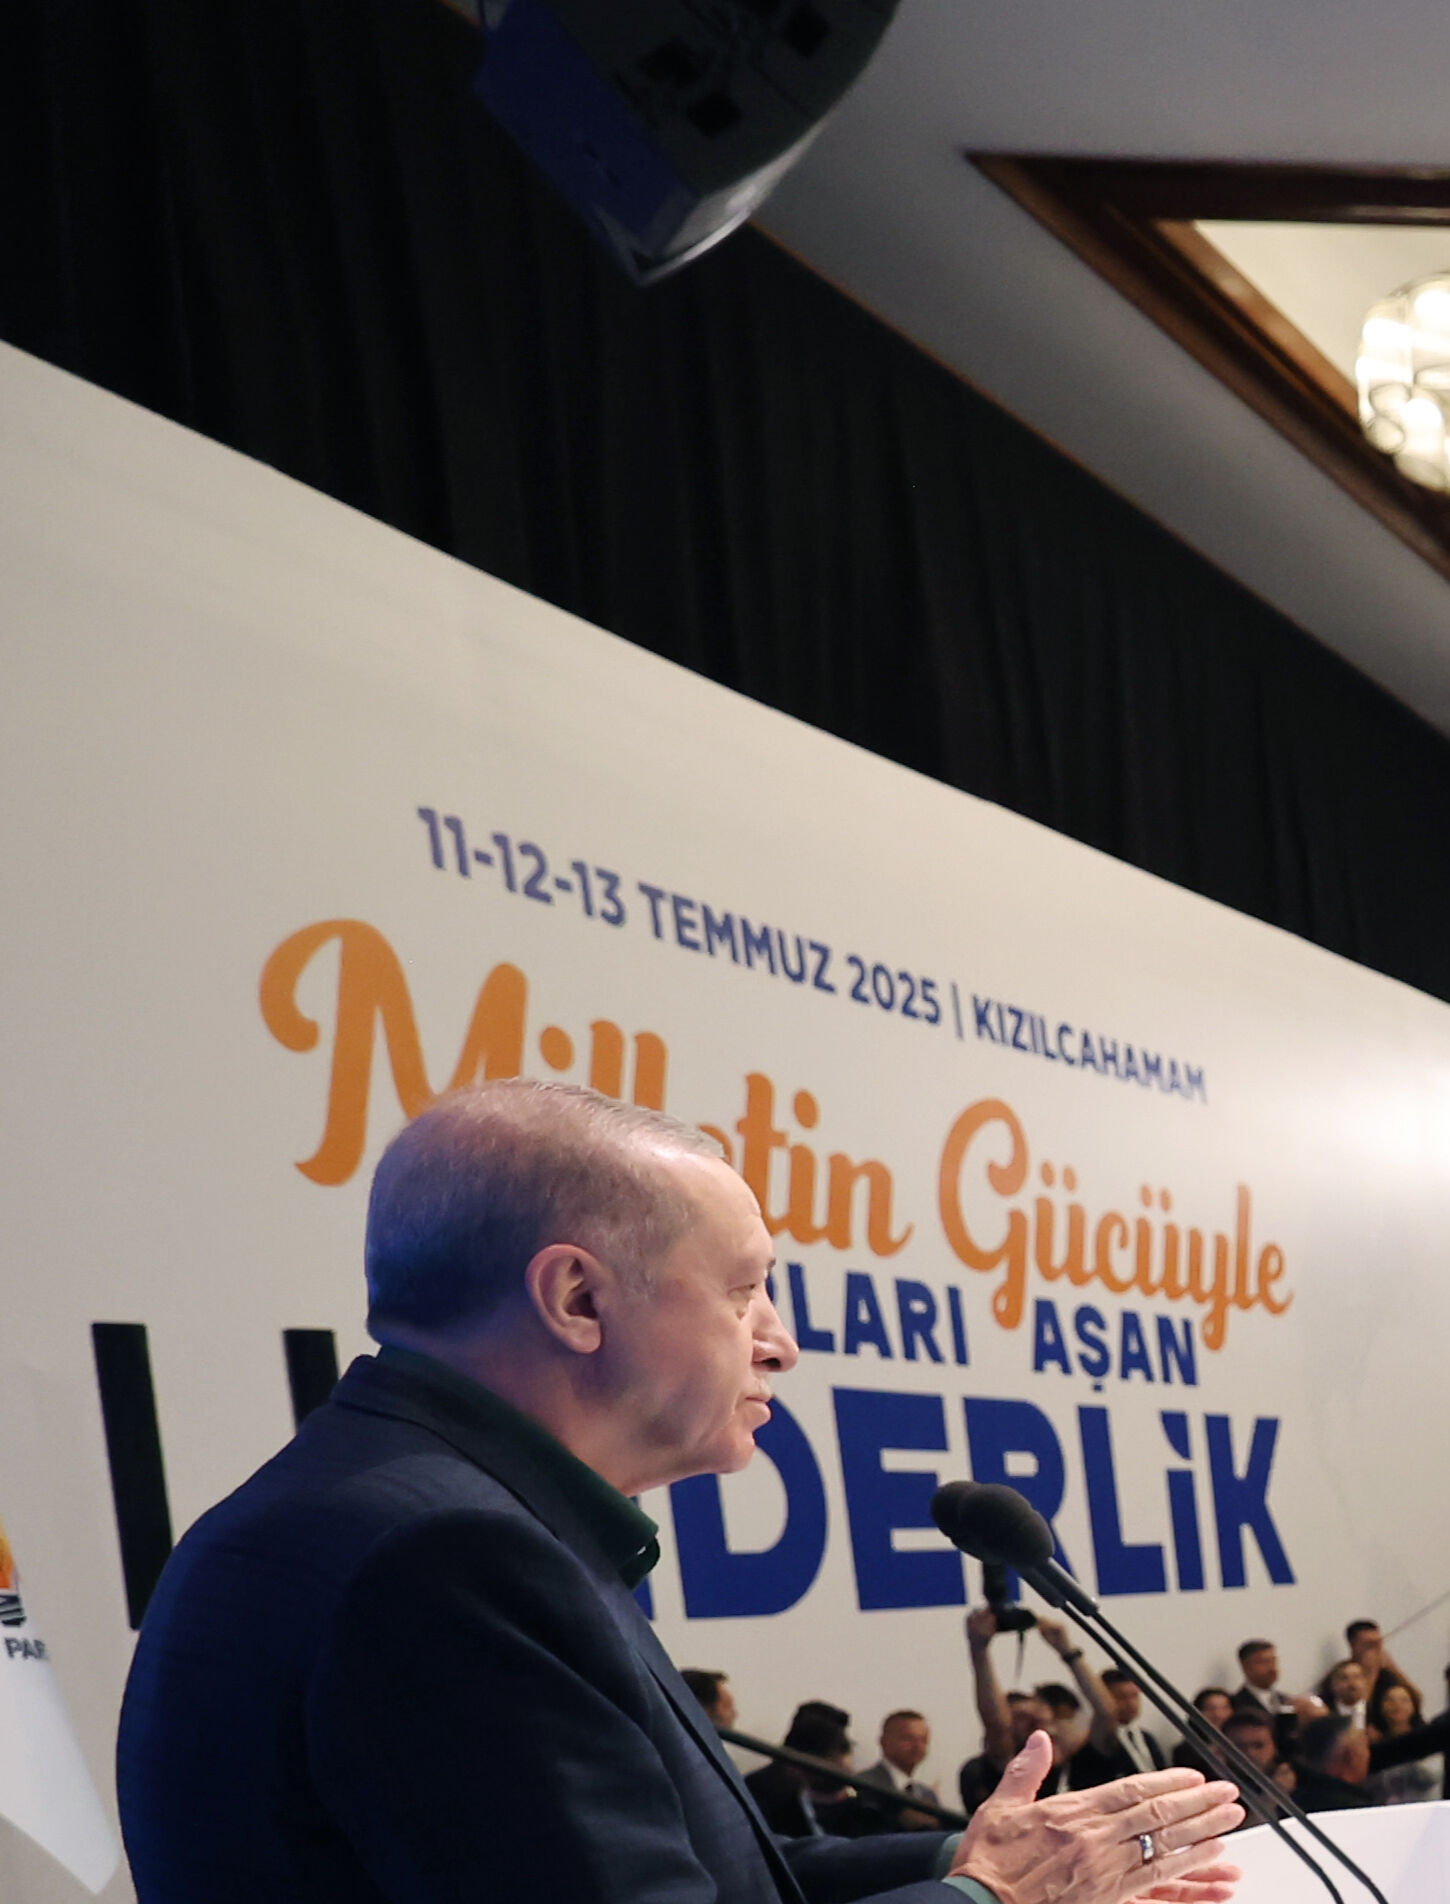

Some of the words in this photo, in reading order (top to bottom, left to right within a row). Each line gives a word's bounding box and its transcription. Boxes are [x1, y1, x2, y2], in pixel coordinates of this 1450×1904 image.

[416, 806, 627, 927] 11-12-13
[637, 882, 837, 994] TEMMUZ
[846, 956, 941, 1027] 2025
[973, 995, 1208, 1104] KIZILCAHAMAM
[938, 1097, 1294, 1352] Gücüyle
[1032, 1297, 1200, 1392] AŞAN
[636, 1385, 1296, 1621] DERLİK
